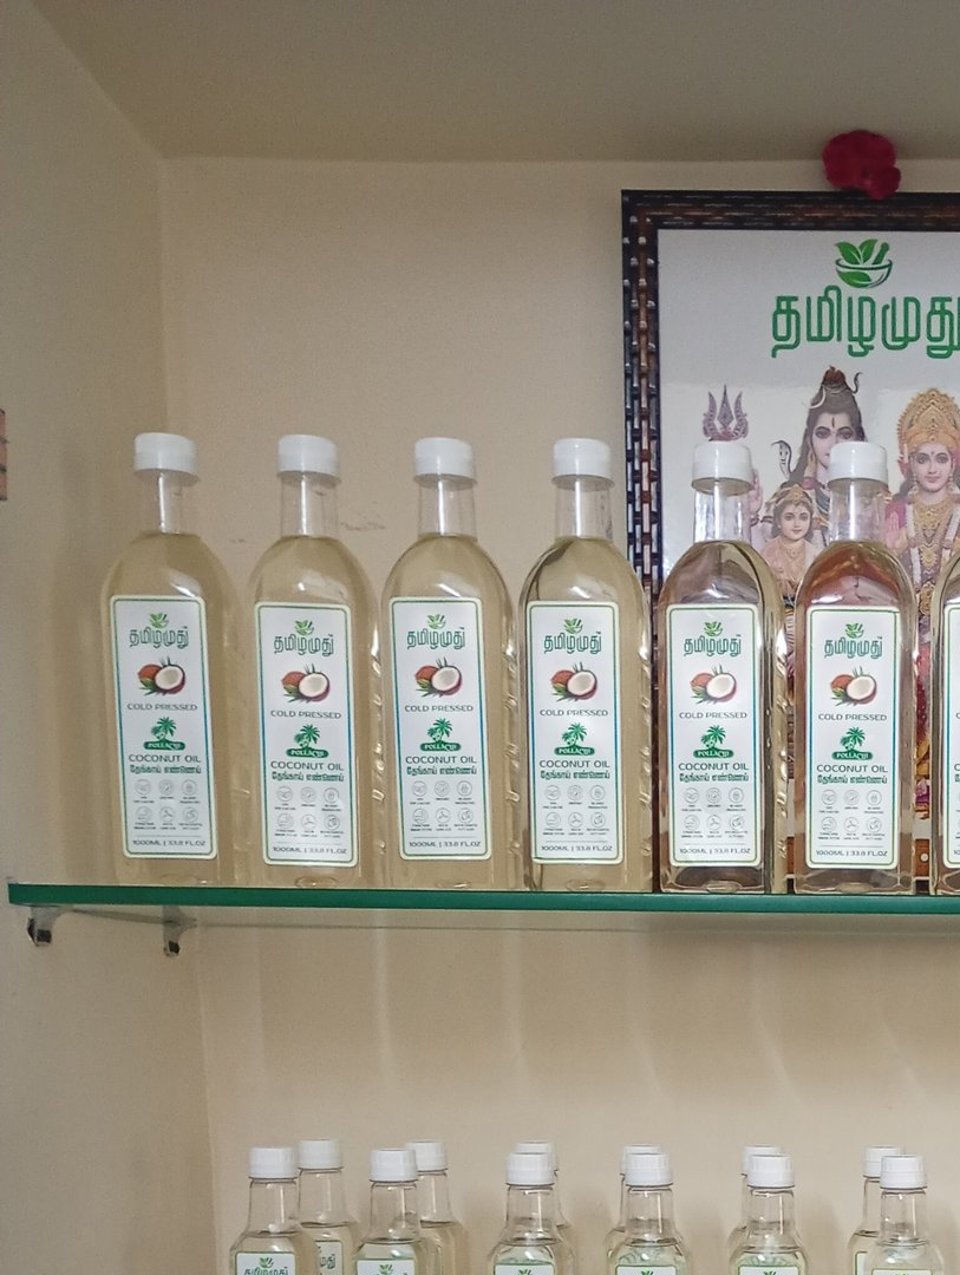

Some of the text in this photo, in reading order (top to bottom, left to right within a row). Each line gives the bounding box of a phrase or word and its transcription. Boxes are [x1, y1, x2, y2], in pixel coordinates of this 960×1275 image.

[155, 703, 197, 711] PRESSED
[270, 709, 341, 719] COLD PRESSED
[706, 711, 747, 719] PRESSED
[845, 713, 887, 721] PRESSED
[128, 753, 201, 763] COCONUT OIL
[405, 755, 477, 763] COCONUT OIL
[270, 760, 344, 771] COCONUT OIL
[539, 759, 610, 768] COCONUT OIL
[678, 762, 749, 770] COCONUT OIL
[816, 763, 887, 773] COCONUT OIL
